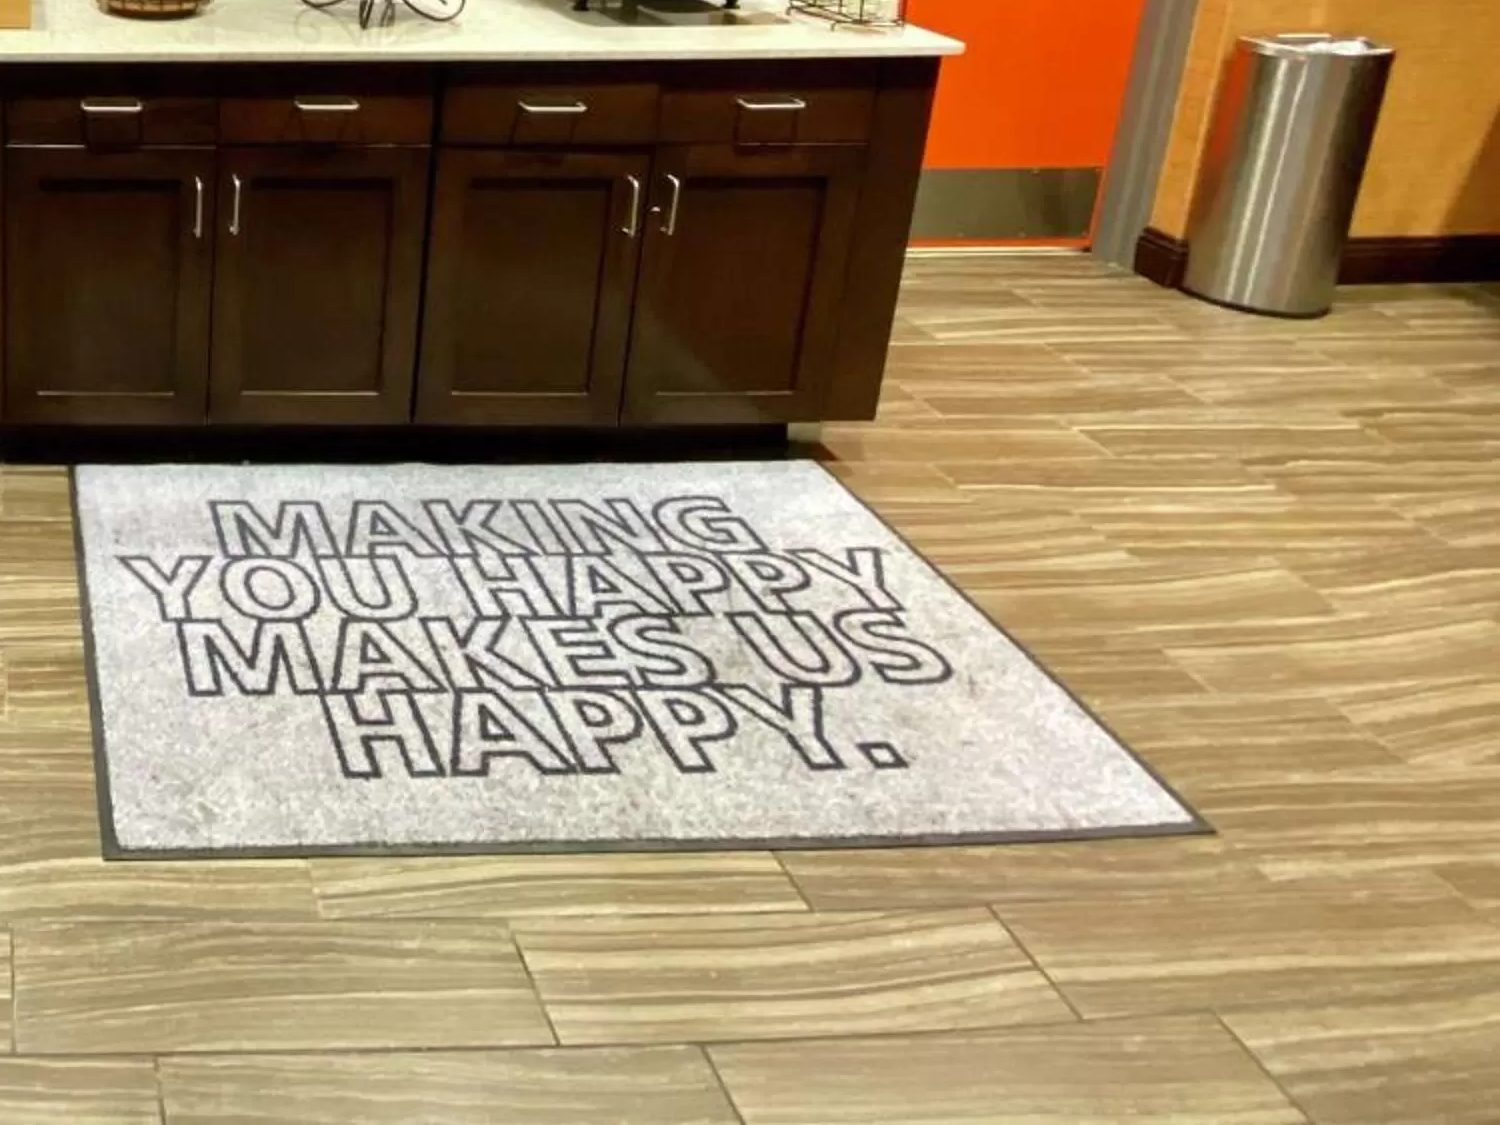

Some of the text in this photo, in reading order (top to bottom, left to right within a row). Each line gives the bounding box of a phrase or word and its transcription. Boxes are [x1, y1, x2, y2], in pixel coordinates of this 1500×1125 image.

[208, 495, 771, 558] MAKING
[115, 547, 906, 622] YOU HAPPY
[175, 608, 954, 697] MAKES US
[317, 681, 910, 780] HAPPY.
